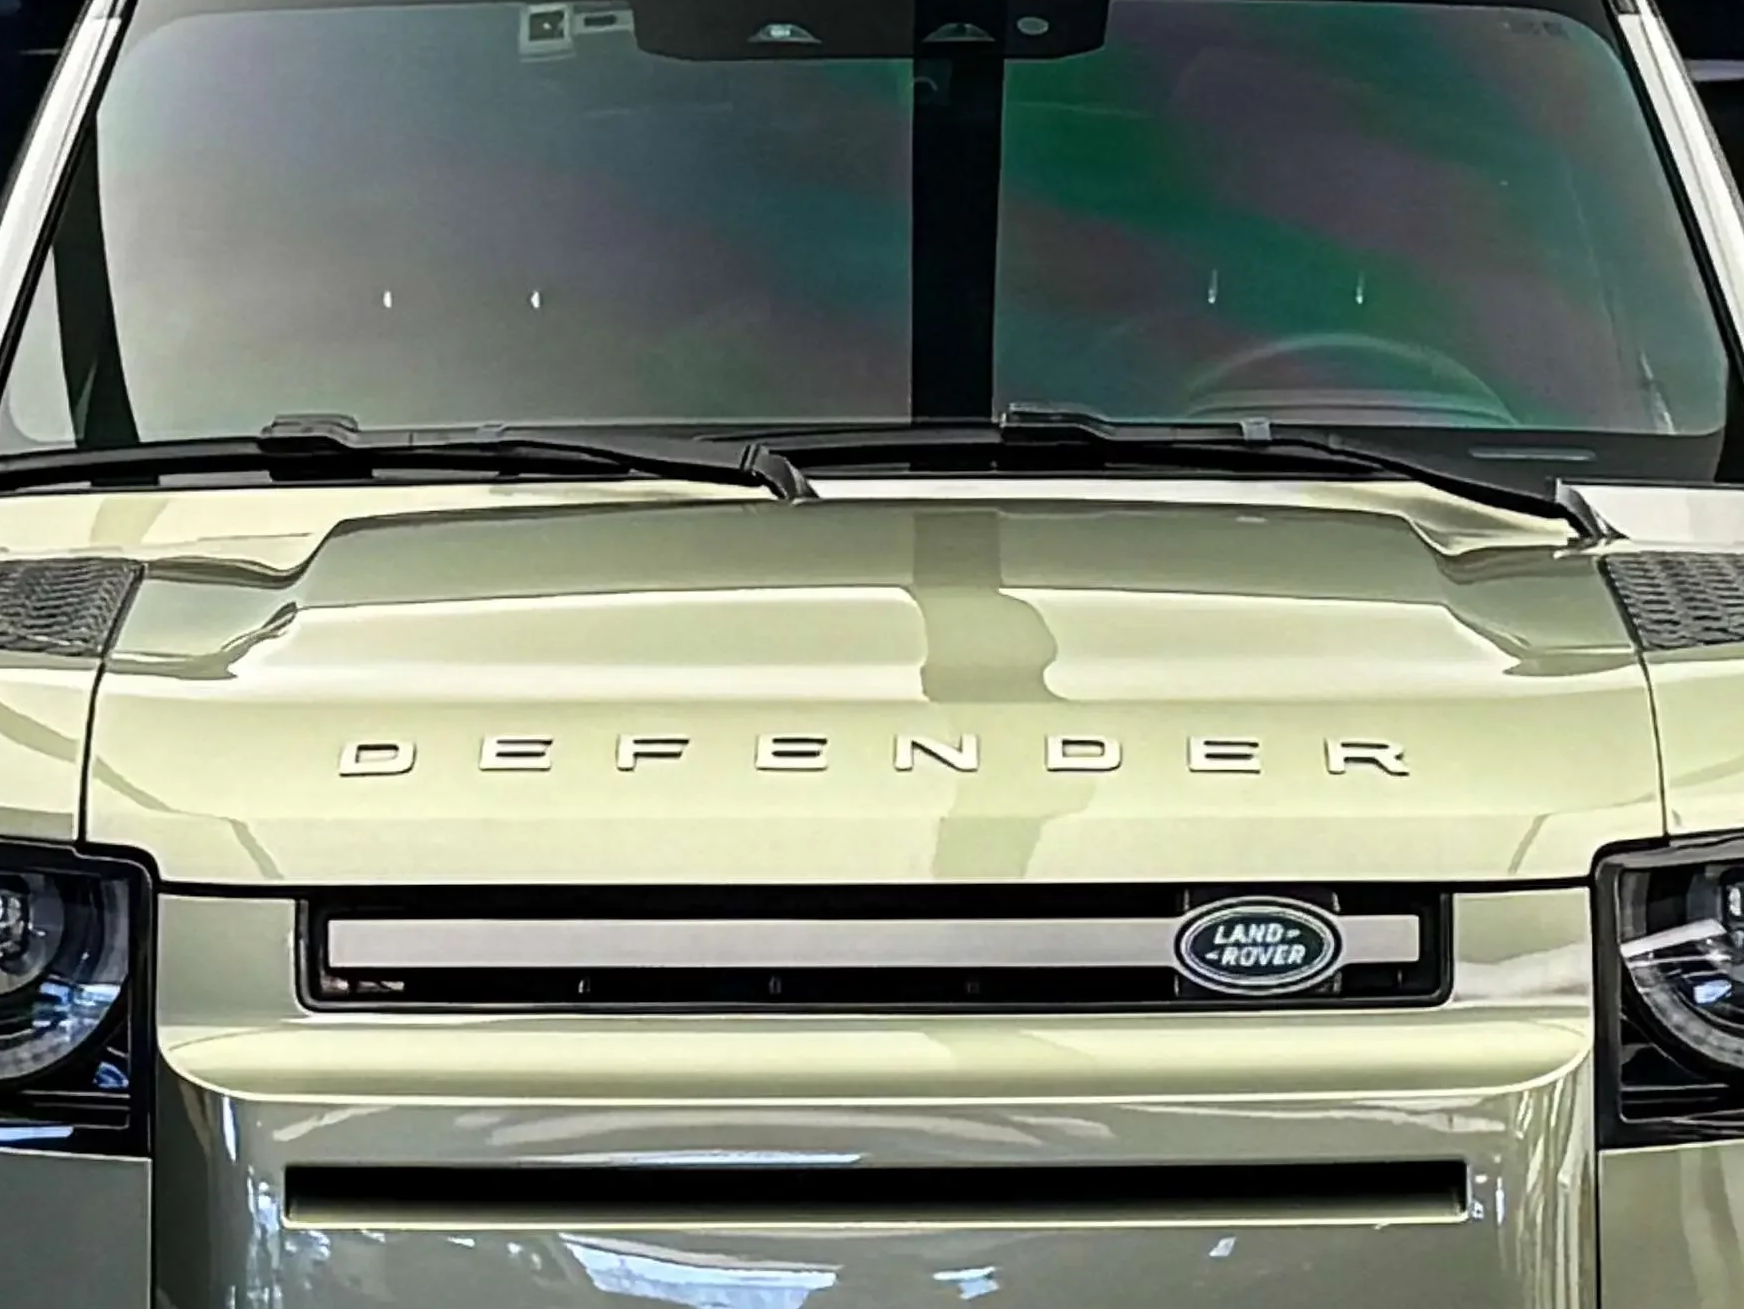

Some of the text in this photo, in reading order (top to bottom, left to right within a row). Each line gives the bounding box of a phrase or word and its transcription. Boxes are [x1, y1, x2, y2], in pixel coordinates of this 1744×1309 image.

[337, 732, 1413, 777] DEFENDER
[1213, 922, 1285, 945] LAND
[1220, 943, 1306, 967] ROVER
